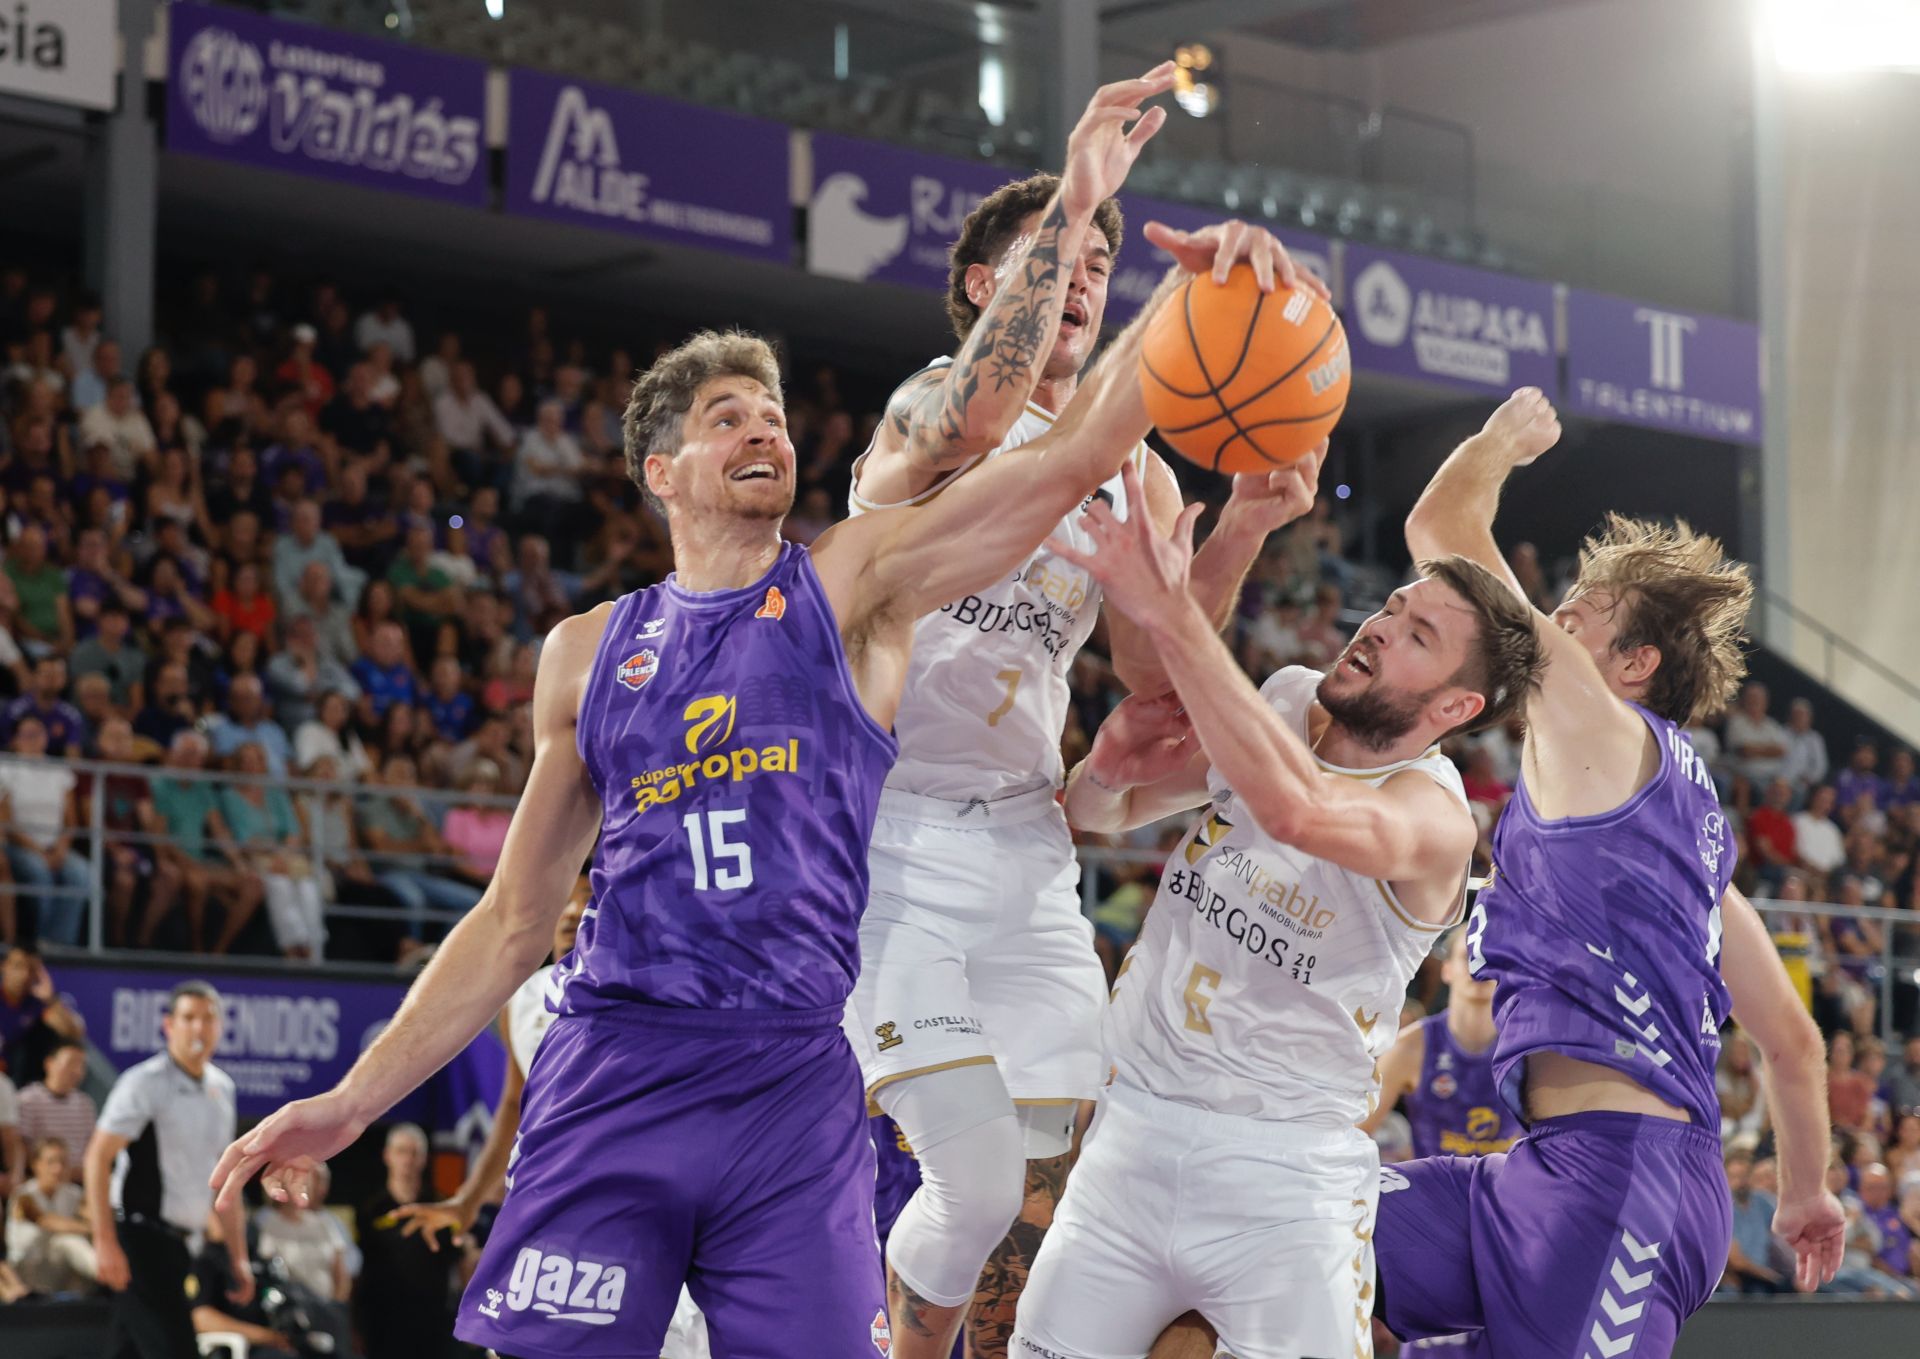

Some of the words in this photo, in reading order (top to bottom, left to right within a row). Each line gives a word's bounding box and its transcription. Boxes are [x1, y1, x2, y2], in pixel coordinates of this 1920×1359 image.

[269, 70, 479, 186] Valdés
[554, 159, 650, 222] ALDE
[1413, 289, 1549, 356] AUPASA
[987, 669, 1024, 728] 7
[631, 764, 686, 789] súper
[683, 808, 754, 892] 15
[1184, 869, 1289, 968] BURGOS
[1258, 901, 1324, 941] INMOBILIARIA
[1294, 952, 1317, 970] 20
[111, 988, 340, 1062] BIEENIDOS
[913, 1015, 969, 1030] CASTILLA
[1184, 962, 1222, 1036] 6
[506, 1246, 627, 1312] gaza
